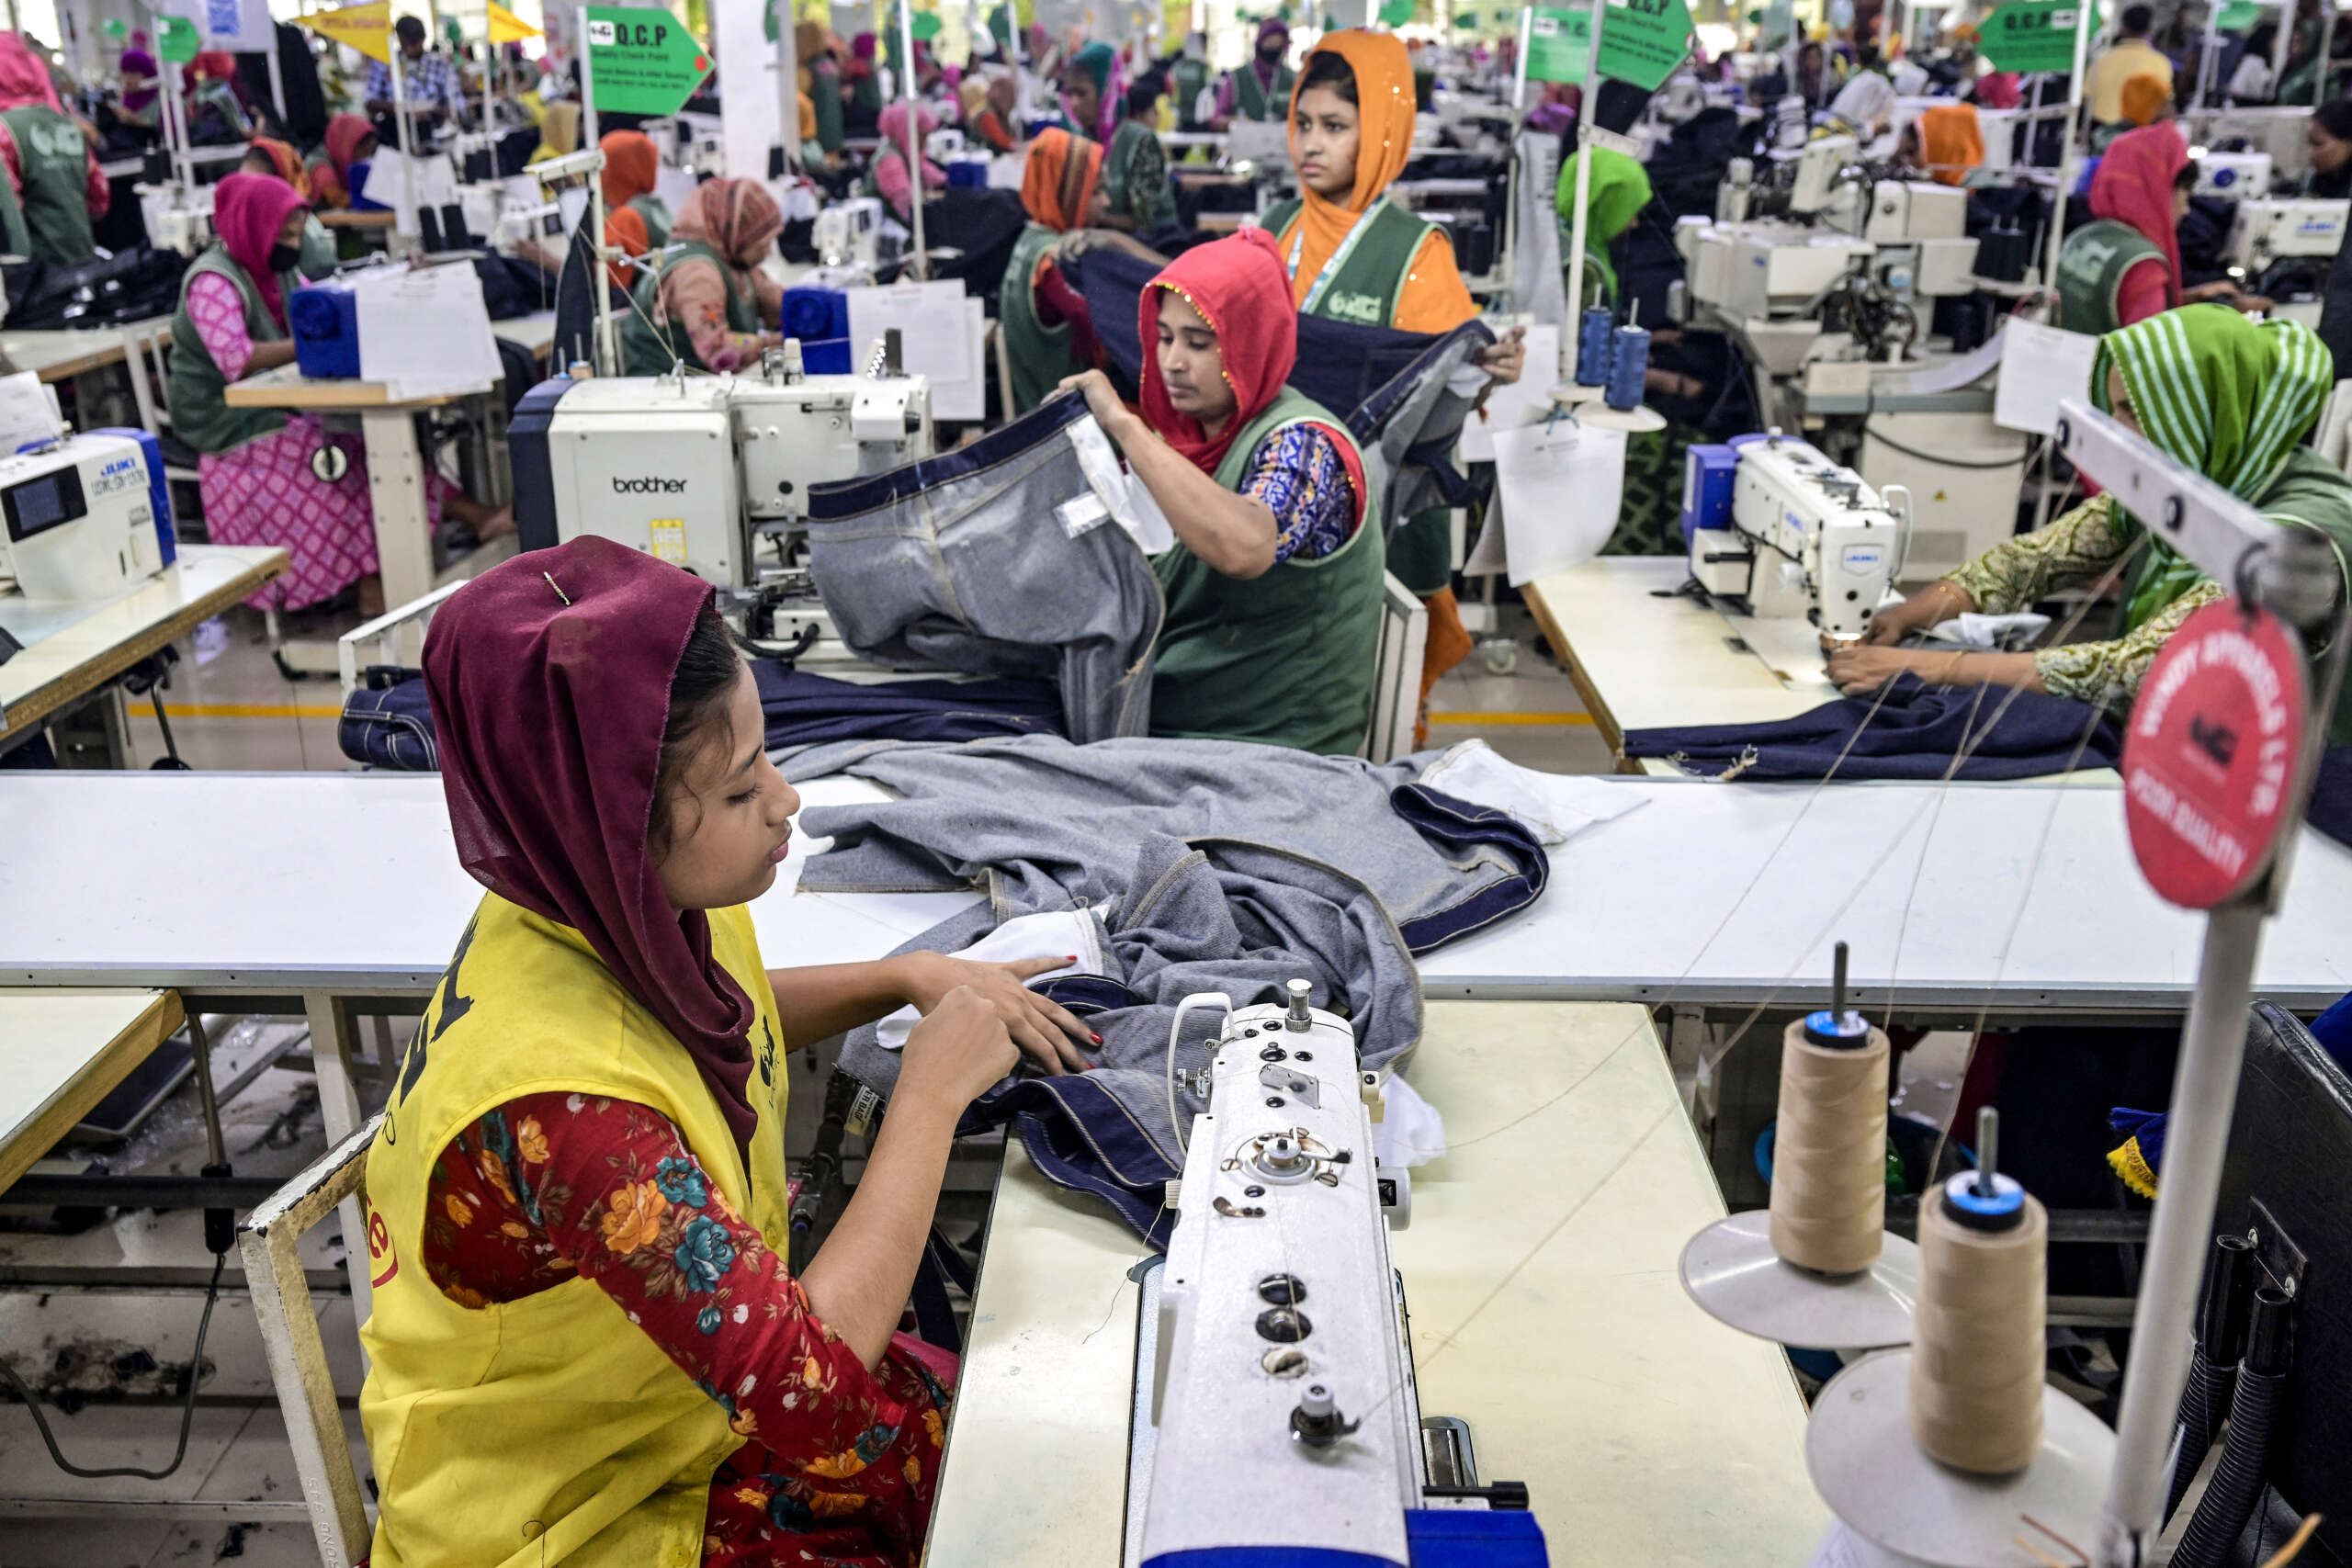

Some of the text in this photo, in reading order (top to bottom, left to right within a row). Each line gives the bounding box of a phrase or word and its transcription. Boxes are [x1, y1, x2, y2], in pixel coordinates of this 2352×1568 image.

[616, 23, 668, 47] Q.C.P
[100, 457, 136, 476] JUKI
[612, 476, 687, 493] brother
[2129, 766, 2247, 878] FOR QUALITY
